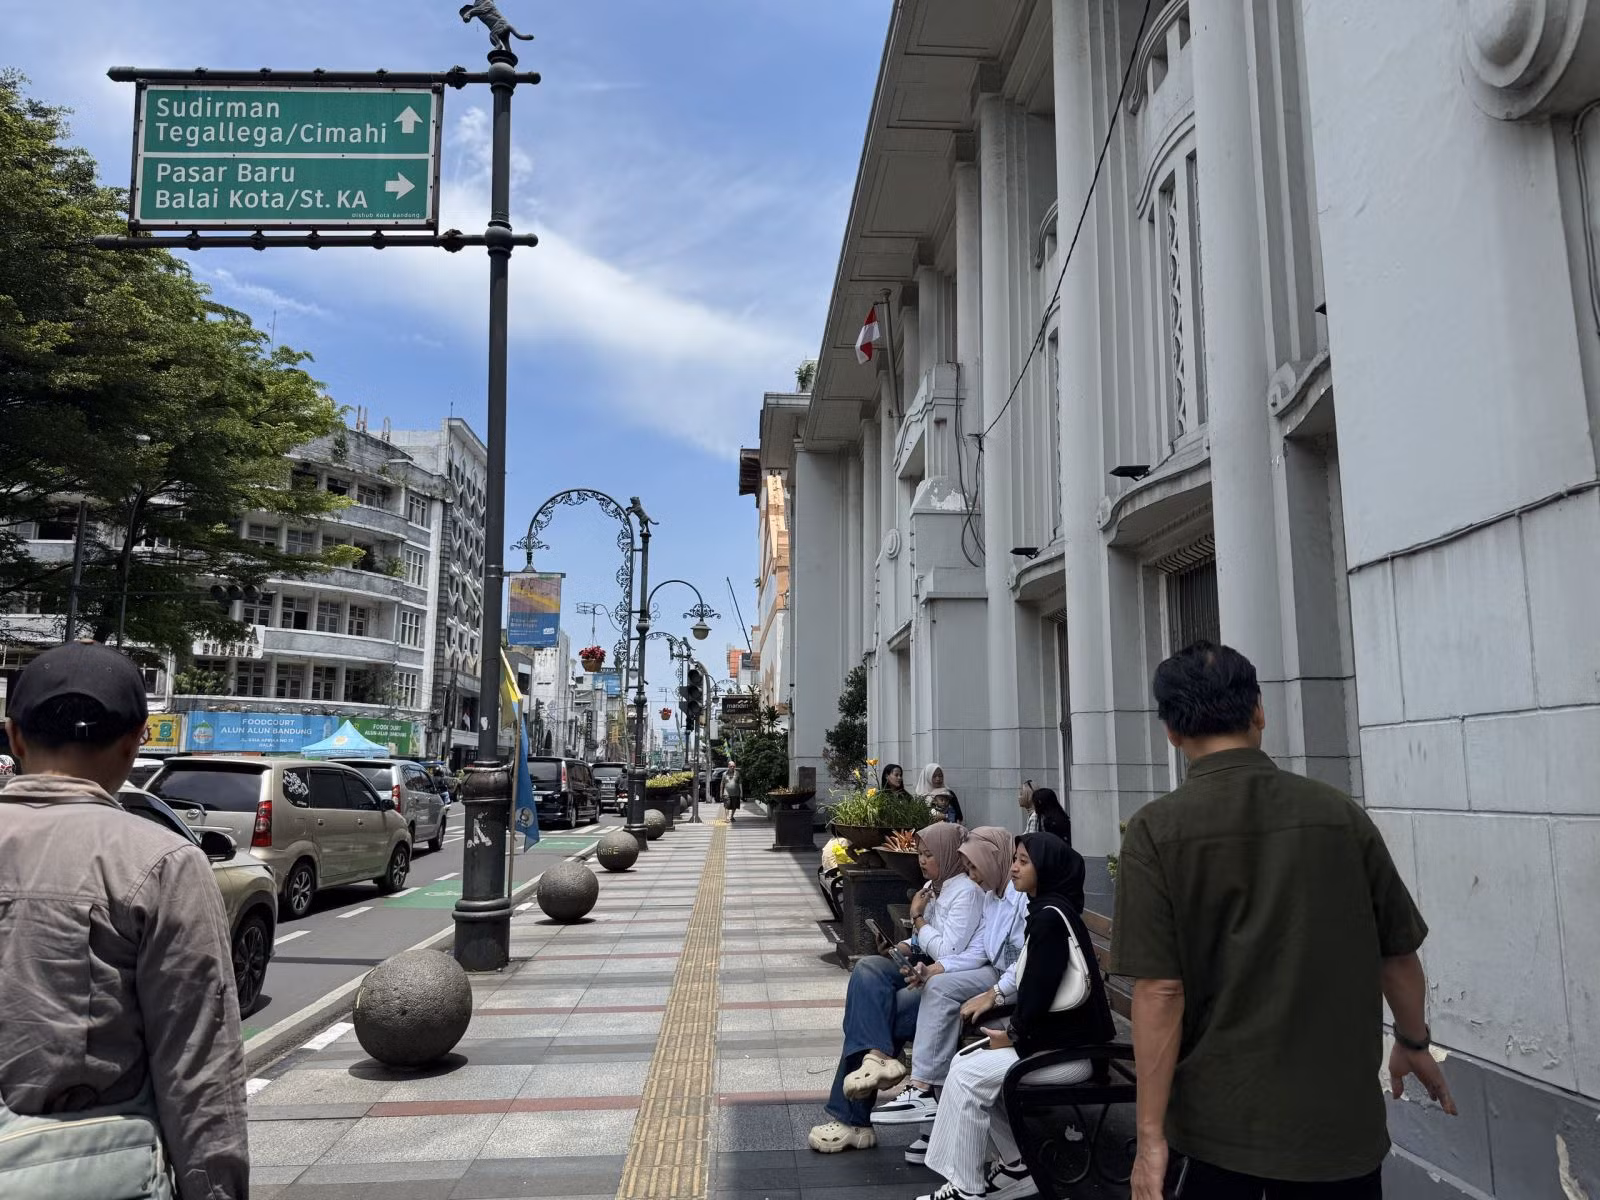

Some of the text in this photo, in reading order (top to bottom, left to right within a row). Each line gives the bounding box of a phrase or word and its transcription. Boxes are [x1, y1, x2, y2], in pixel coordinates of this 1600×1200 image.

[156, 96, 280, 118] Sudirman
[155, 121, 387, 147] Tegallega/Cimahi
[156, 163, 295, 183] Pasar Baru
[155, 187, 368, 211] Balai Kota/St. KA
[220, 726, 245, 734] ALUN
